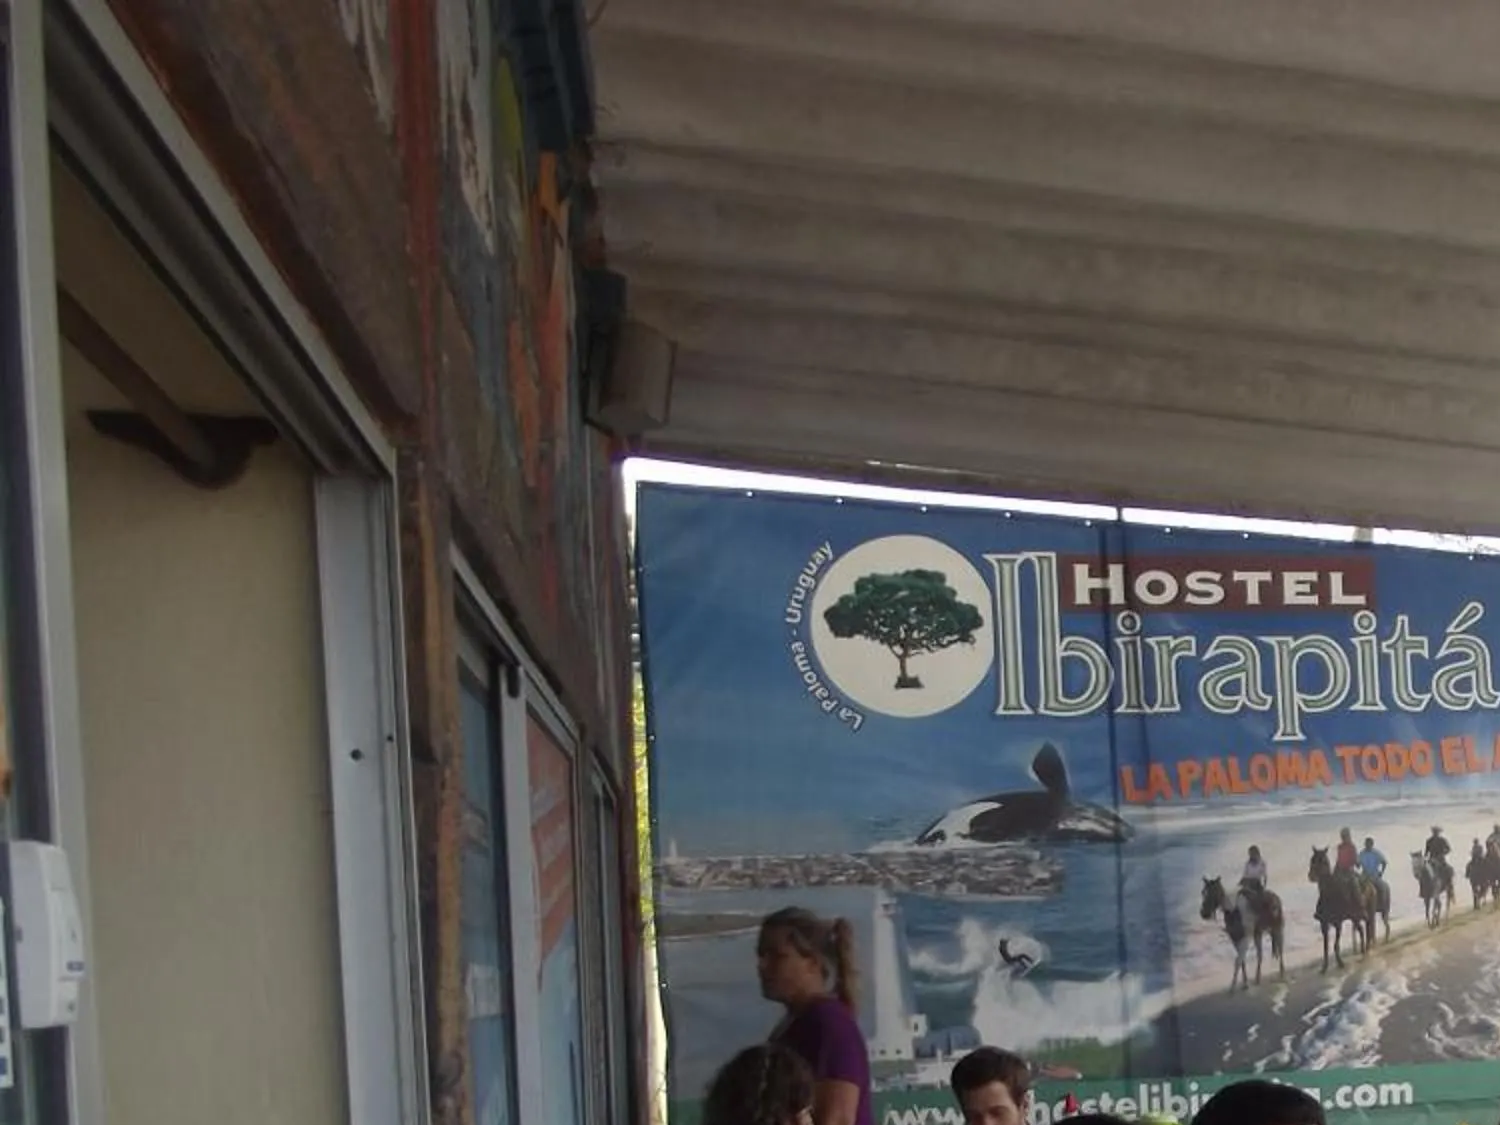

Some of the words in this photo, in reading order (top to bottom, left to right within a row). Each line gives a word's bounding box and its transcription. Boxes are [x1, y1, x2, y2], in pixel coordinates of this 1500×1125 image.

[785, 541, 834, 624] Uruguay
[1071, 562, 1367, 606] HOSTEL
[791, 640, 838, 712] Paloma
[839, 706, 864, 730] La
[1120, 760, 1174, 803] LA
[1176, 748, 1333, 799] PALOMA
[1335, 740, 1433, 784] TODO
[1440, 734, 1486, 777] EL
